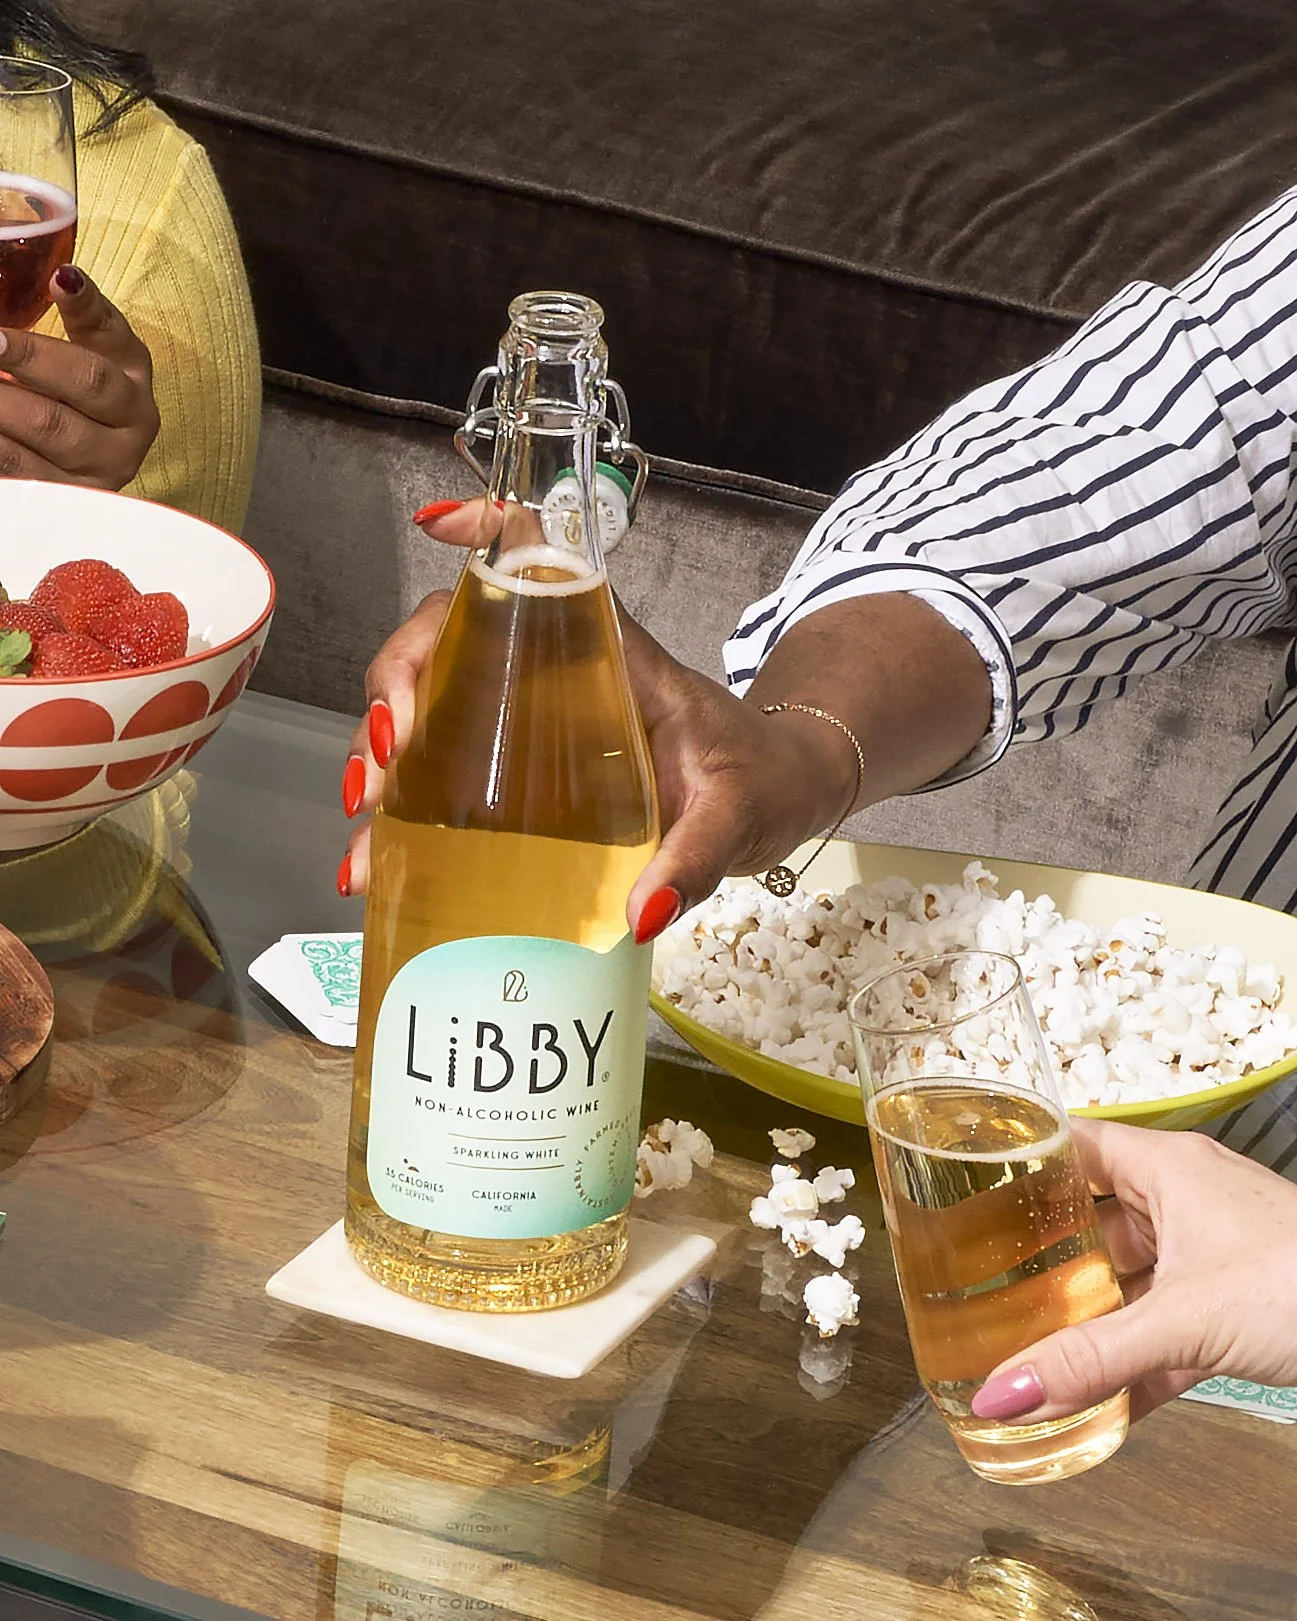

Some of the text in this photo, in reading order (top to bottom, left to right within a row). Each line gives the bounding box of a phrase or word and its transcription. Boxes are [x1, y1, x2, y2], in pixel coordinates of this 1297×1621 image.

[415, 1095, 600, 1121] NON-ALCOHOLIC WINE
[453, 1146, 559, 1160] SPARKLING WHITE
[398, 1173, 444, 1193] CALORIES
[471, 1189, 537, 1201] CALIFORNIA
[493, 1204, 513, 1213] MADE
